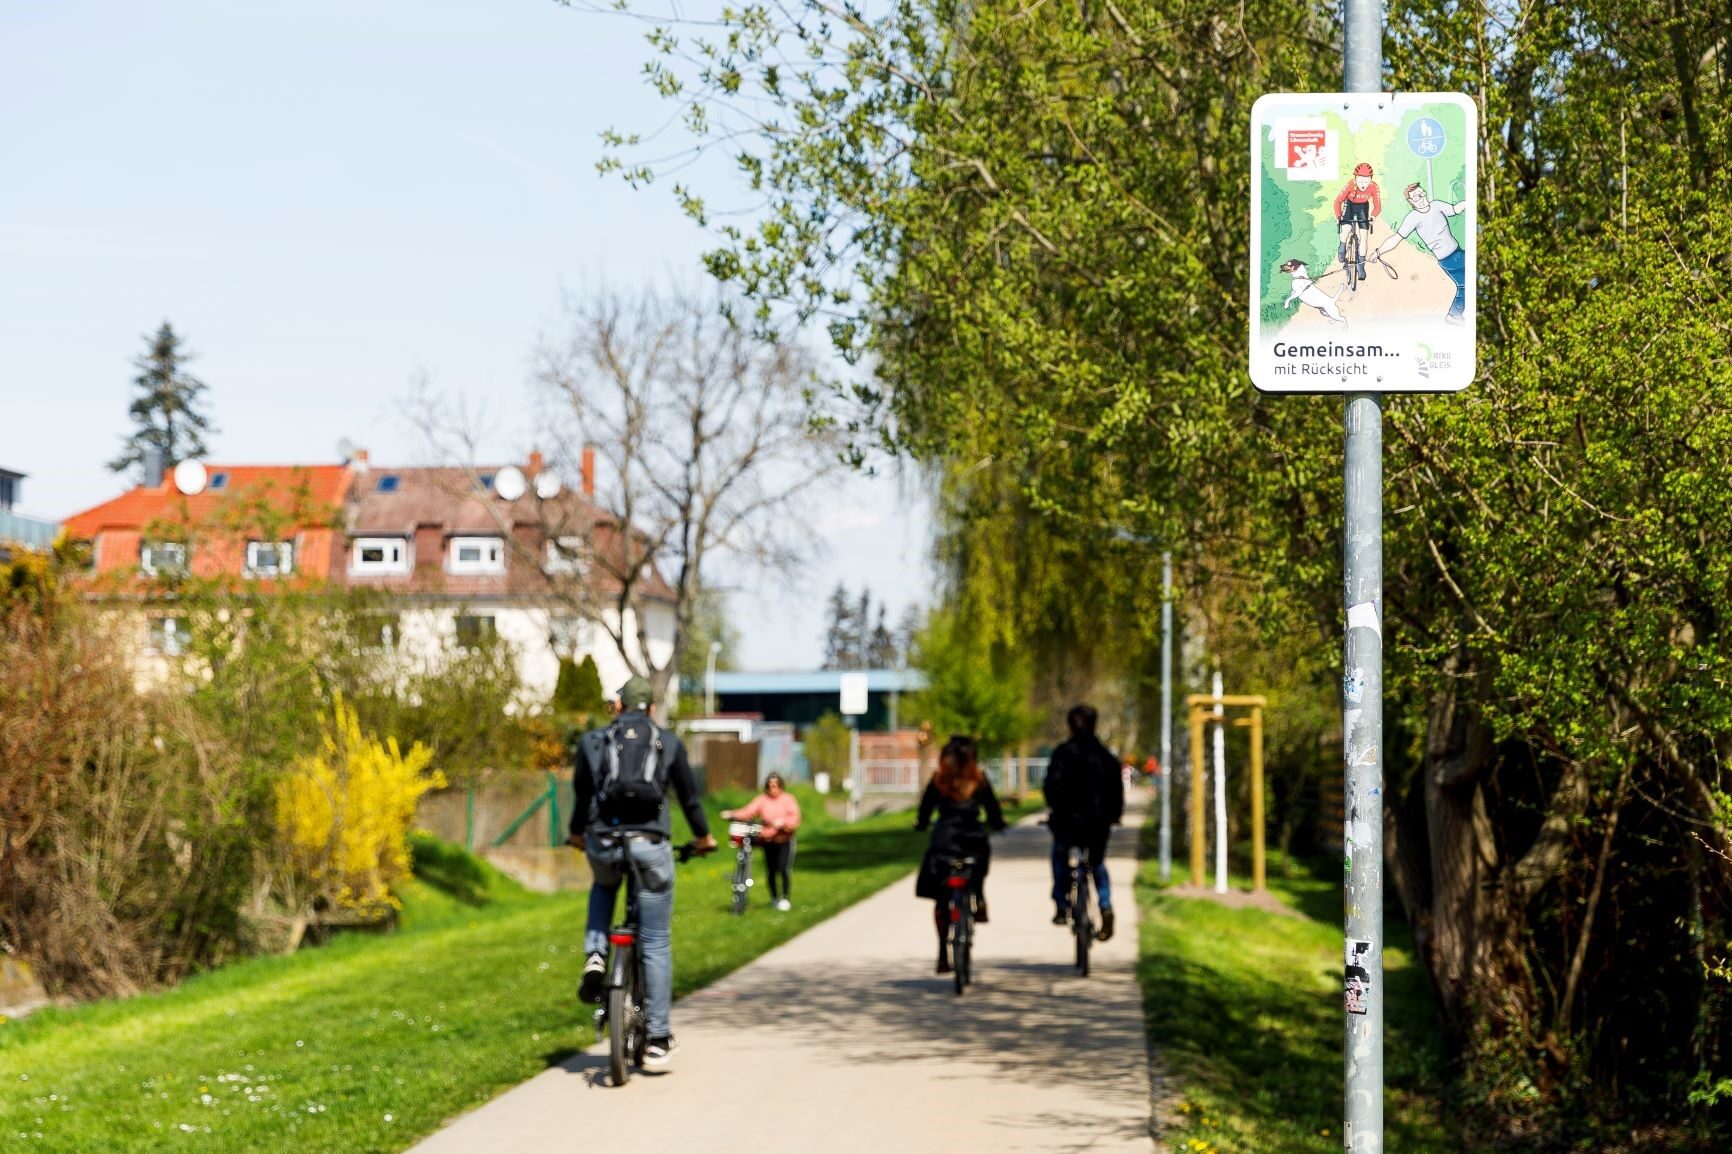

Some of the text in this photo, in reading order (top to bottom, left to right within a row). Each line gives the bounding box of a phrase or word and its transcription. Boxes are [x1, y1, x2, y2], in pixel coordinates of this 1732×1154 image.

[1273, 341, 1400, 358] Gemeinsam...
[1274, 362, 1368, 375] mit Rücksicht
